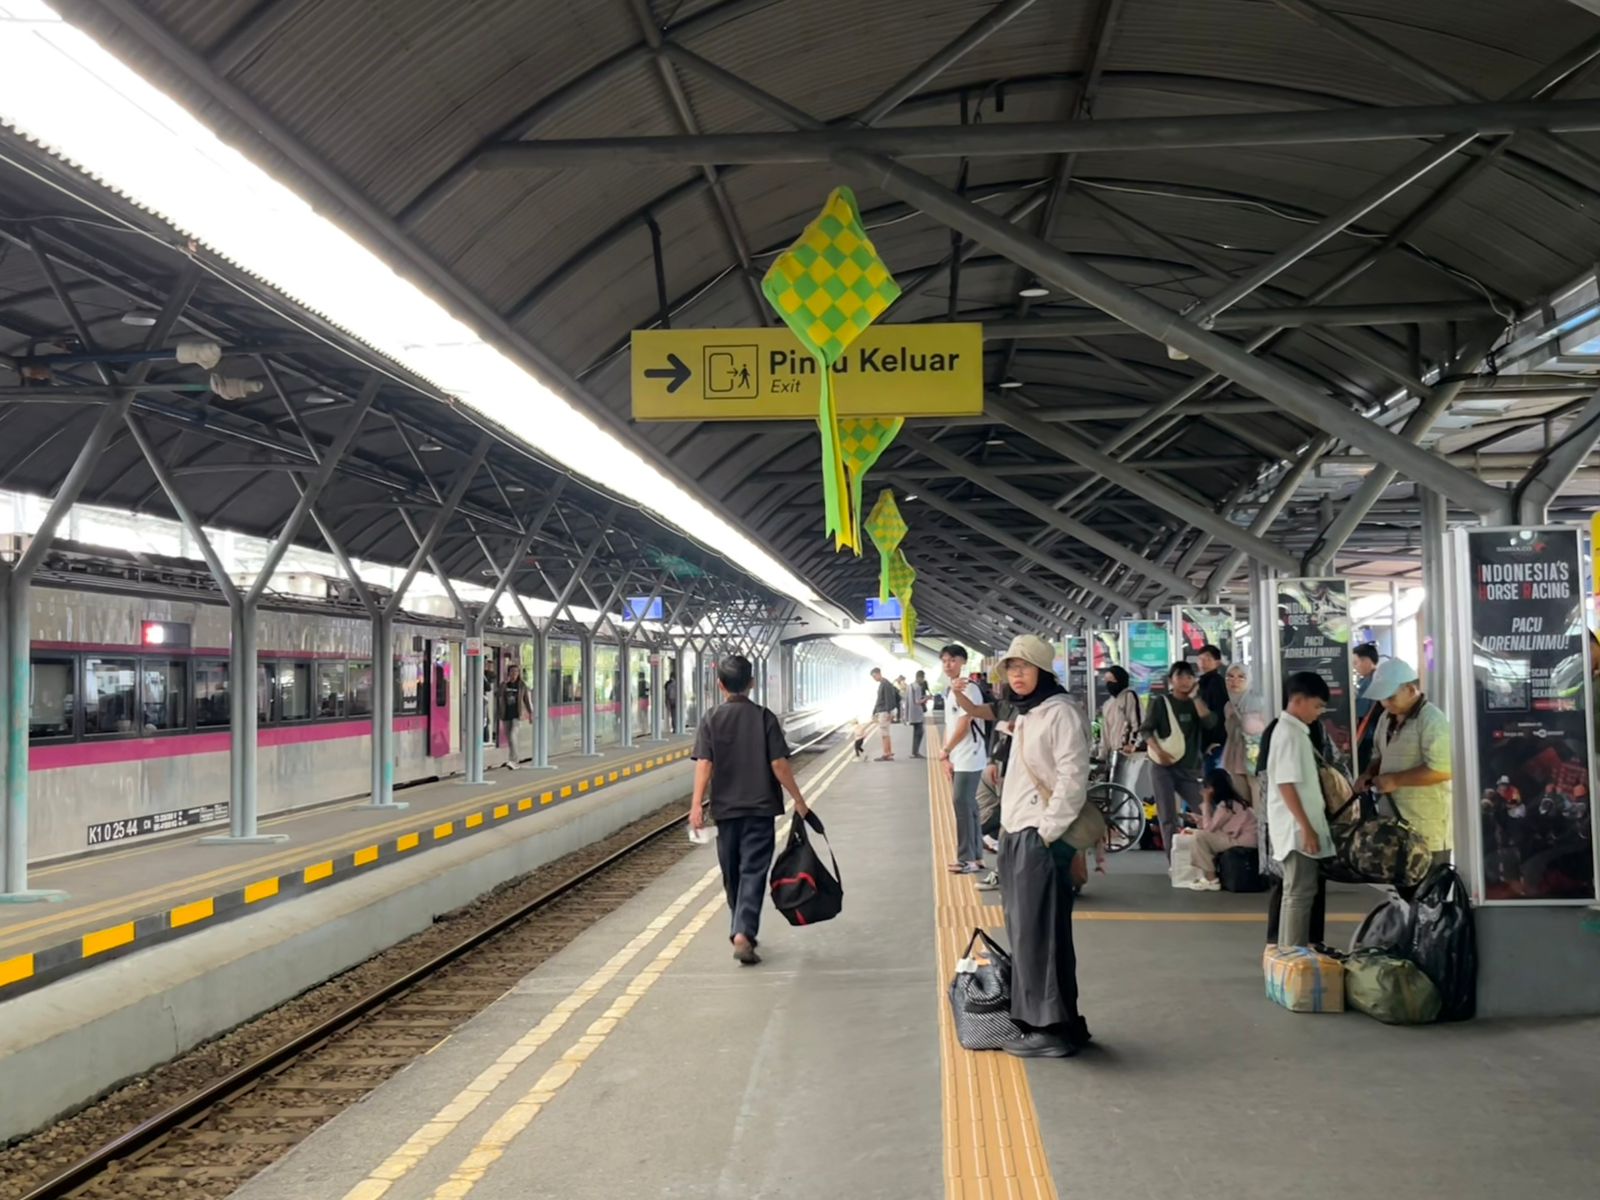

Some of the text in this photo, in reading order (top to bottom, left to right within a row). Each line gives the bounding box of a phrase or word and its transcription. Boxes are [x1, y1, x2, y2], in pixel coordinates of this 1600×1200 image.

[770, 347, 959, 375] Pinu Keluar
[770, 379, 801, 393] Exit
[1478, 560, 1569, 582] INDONESIA'S
[1479, 582, 1570, 601] HORSE RACING
[1511, 616, 1543, 633] PACU
[1481, 634, 1570, 651] ADRENALINMU!
[89, 826, 102, 843] K1
